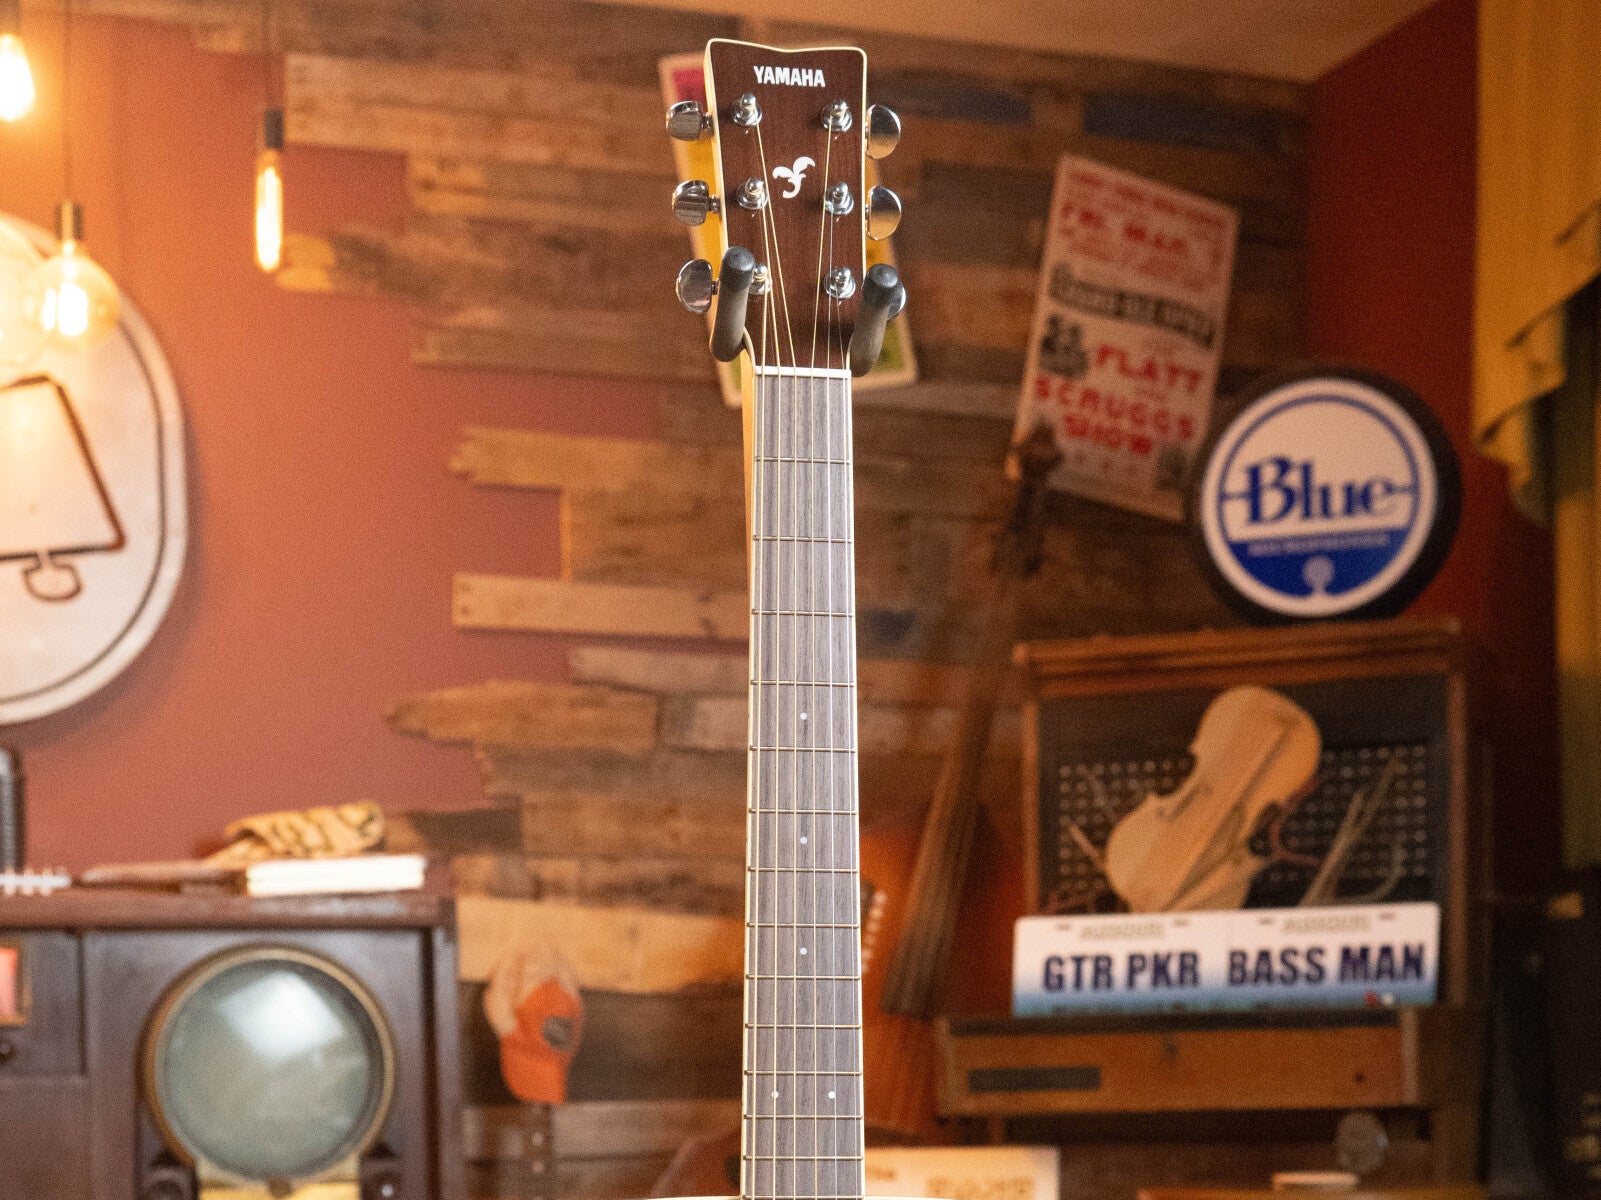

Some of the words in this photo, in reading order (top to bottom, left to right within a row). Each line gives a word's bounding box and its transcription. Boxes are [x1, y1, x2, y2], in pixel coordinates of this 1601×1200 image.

[753, 65, 826, 88] YAMAHA
[1096, 343, 1202, 394] FLATT
[1034, 374, 1195, 442] SCRUGGS
[1062, 412, 1153, 455] SHOW
[1246, 455, 1397, 525] Blue
[1043, 953, 1113, 993] GTR
[1125, 950, 1199, 990] PKR
[1226, 945, 1326, 987] BASS
[1338, 942, 1426, 983] MAN
